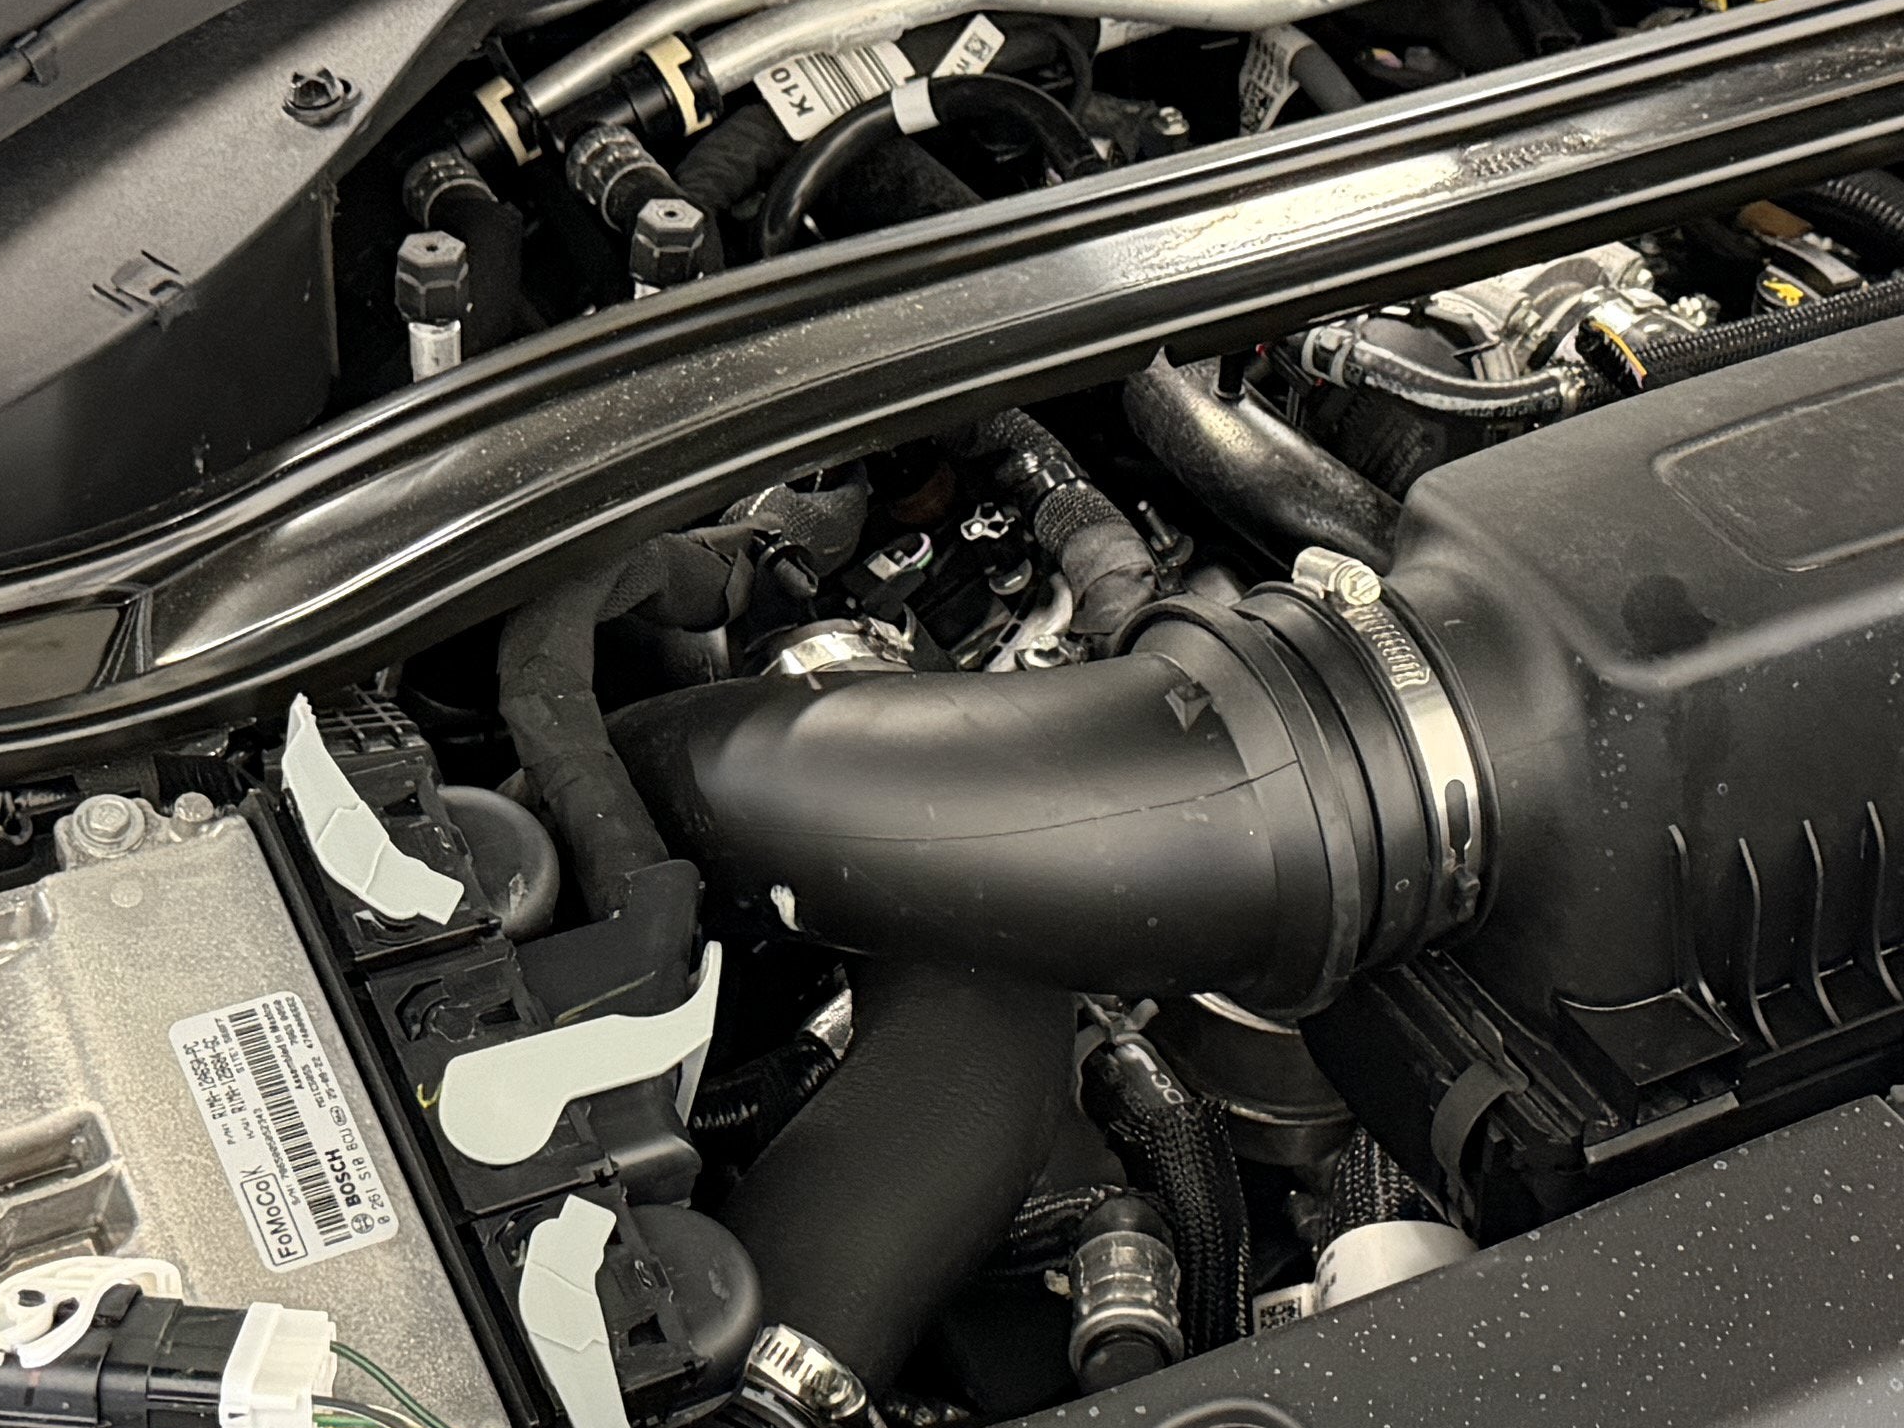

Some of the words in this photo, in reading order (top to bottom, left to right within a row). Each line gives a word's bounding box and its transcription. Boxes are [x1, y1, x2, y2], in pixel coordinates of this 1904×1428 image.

[770, 67, 814, 118] K10
[325, 1149, 360, 1206] BOSCH
[365, 1188, 383, 1209] 261
[256, 1180, 296, 1257] FoMoCo
